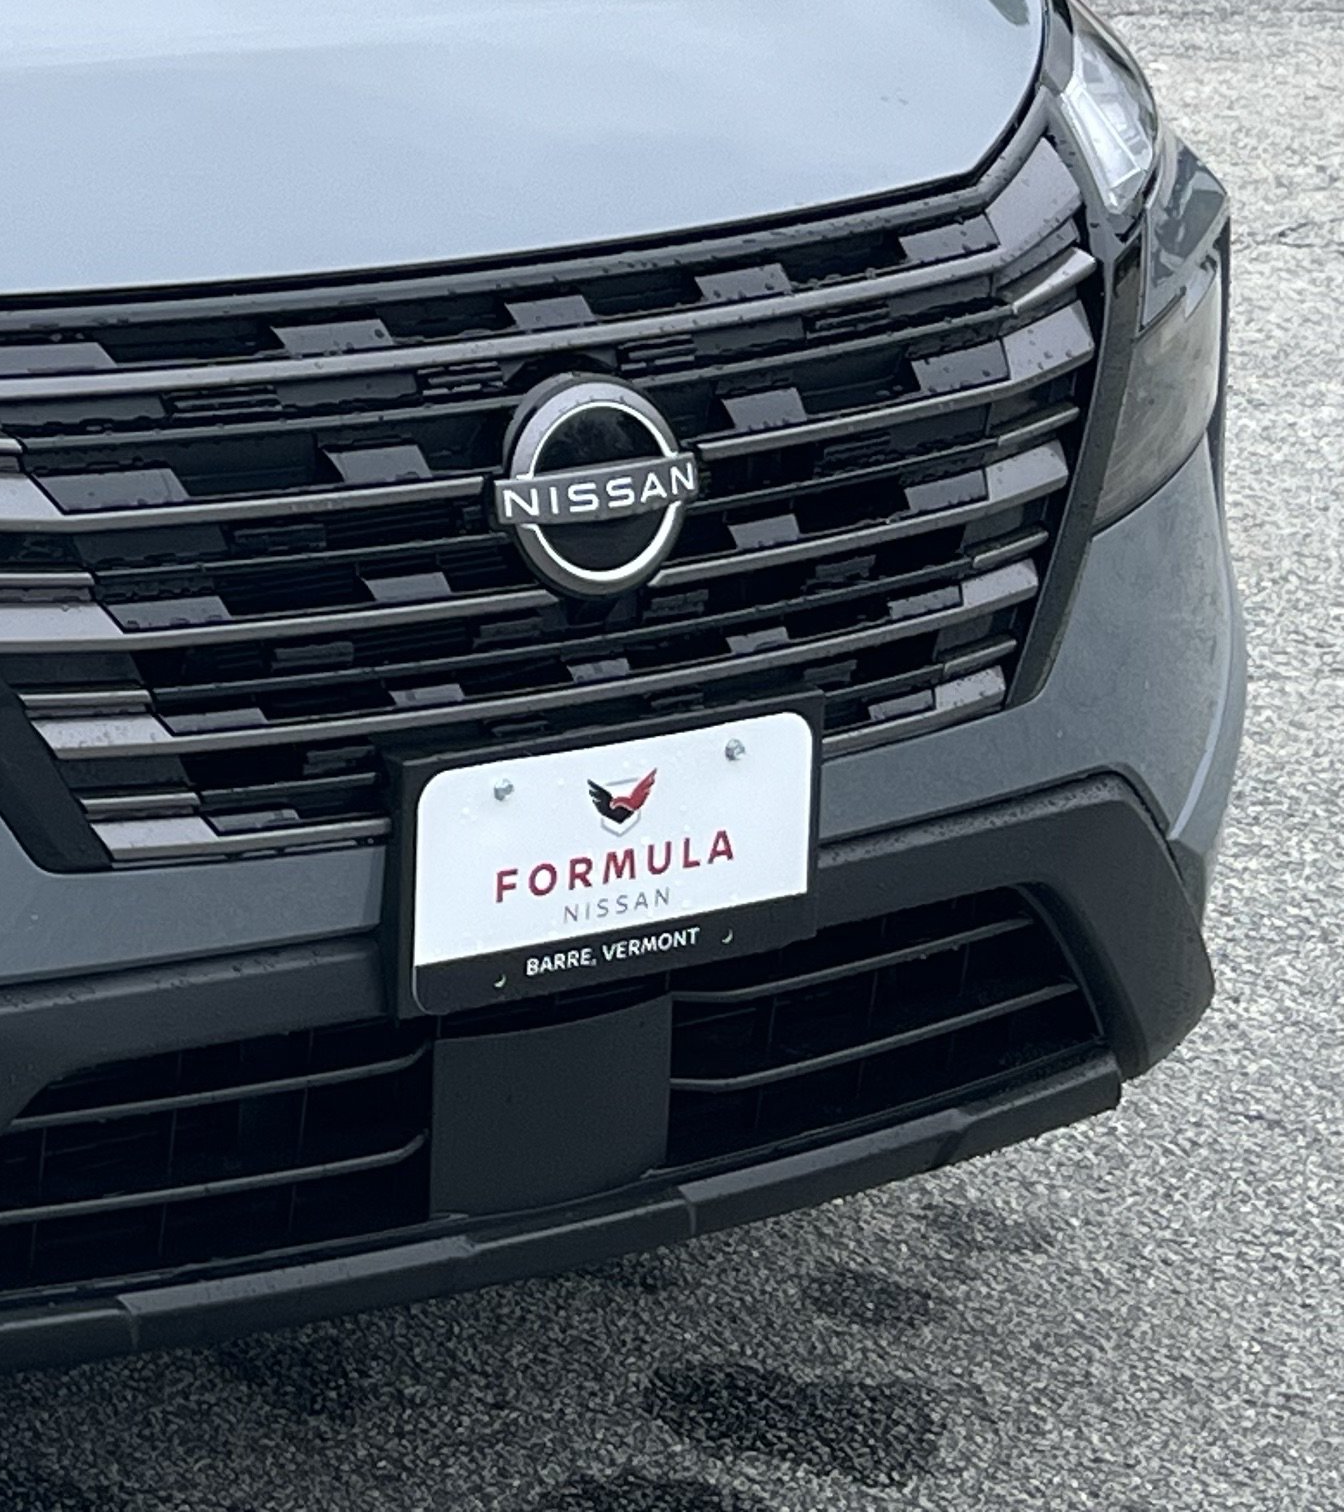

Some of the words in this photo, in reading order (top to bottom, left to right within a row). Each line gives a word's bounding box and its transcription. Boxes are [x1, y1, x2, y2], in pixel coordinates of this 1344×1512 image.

[502, 461, 696, 518] NISSAN
[496, 830, 734, 903] FORMULA
[562, 886, 671, 924] NISSAN
[602, 927, 701, 963] VERMONT
